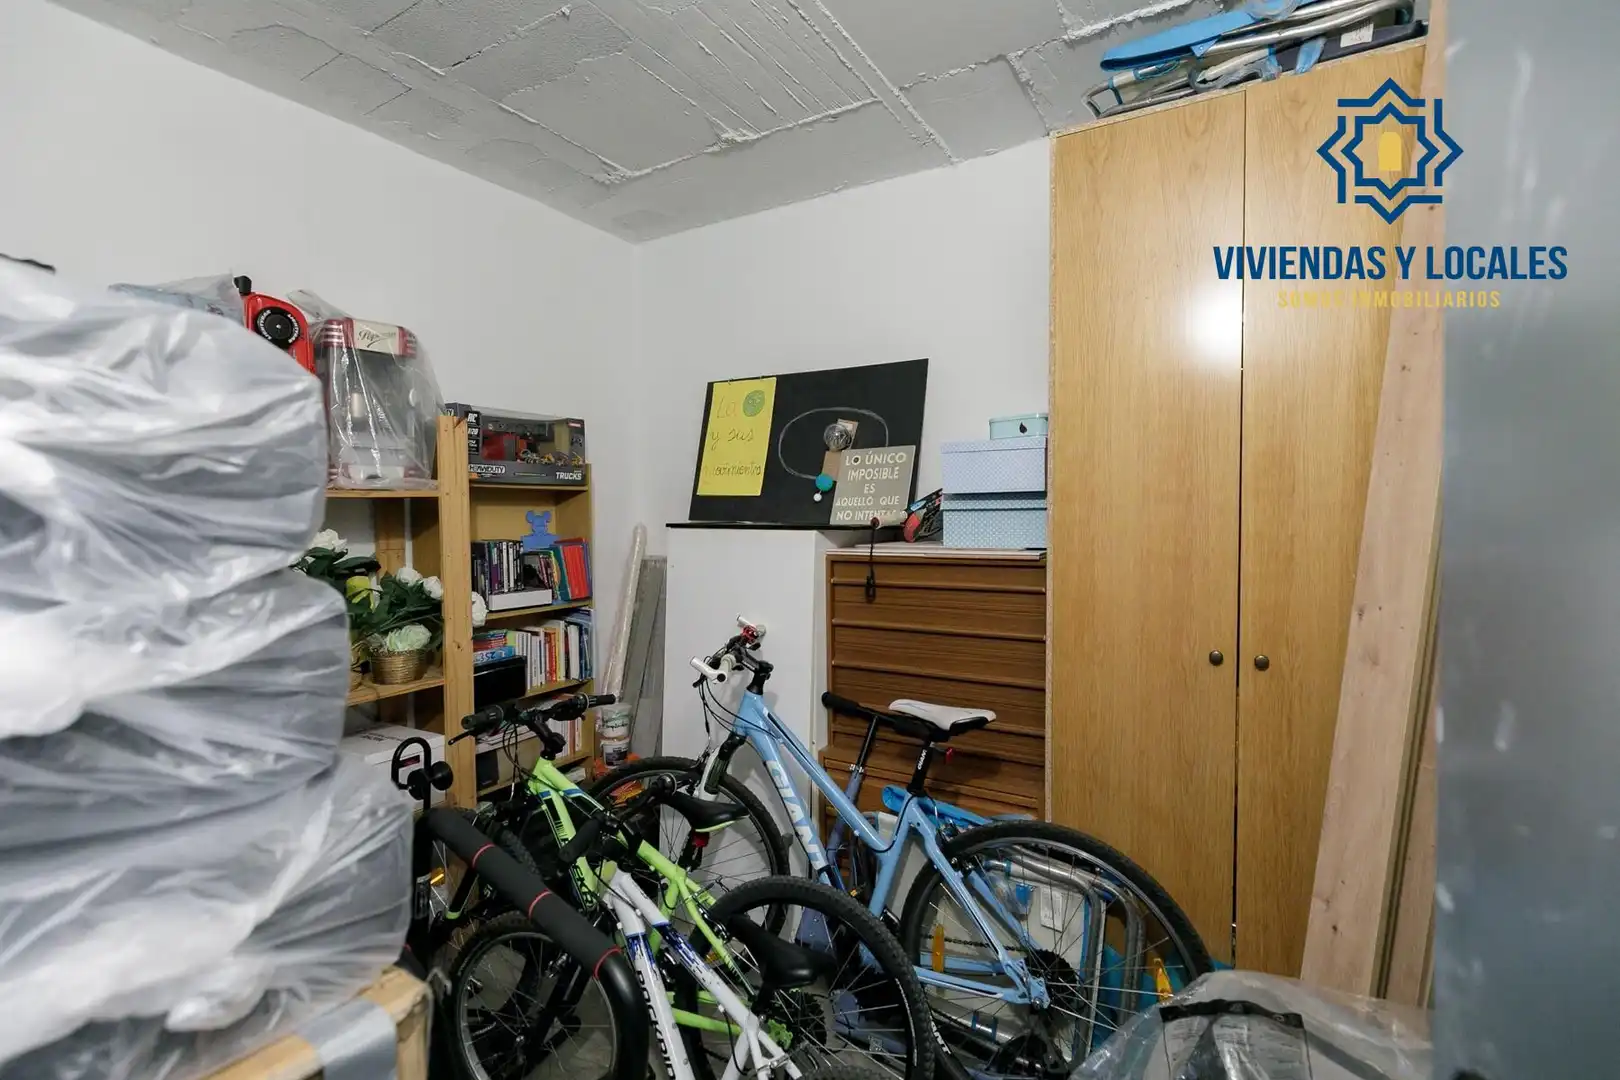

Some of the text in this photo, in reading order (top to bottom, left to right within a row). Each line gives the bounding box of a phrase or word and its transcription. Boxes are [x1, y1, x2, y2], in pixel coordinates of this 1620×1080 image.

[845, 450, 907, 466] LO ÚNICO
[556, 472, 582, 480] TRUCKS
[847, 466, 900, 481] IMPOSIBLE
[863, 483, 876, 494] ES
[835, 495, 900, 506] AQUELLO QUE
[836, 510, 852, 521] NO
[766, 760, 830, 871] GIANT
